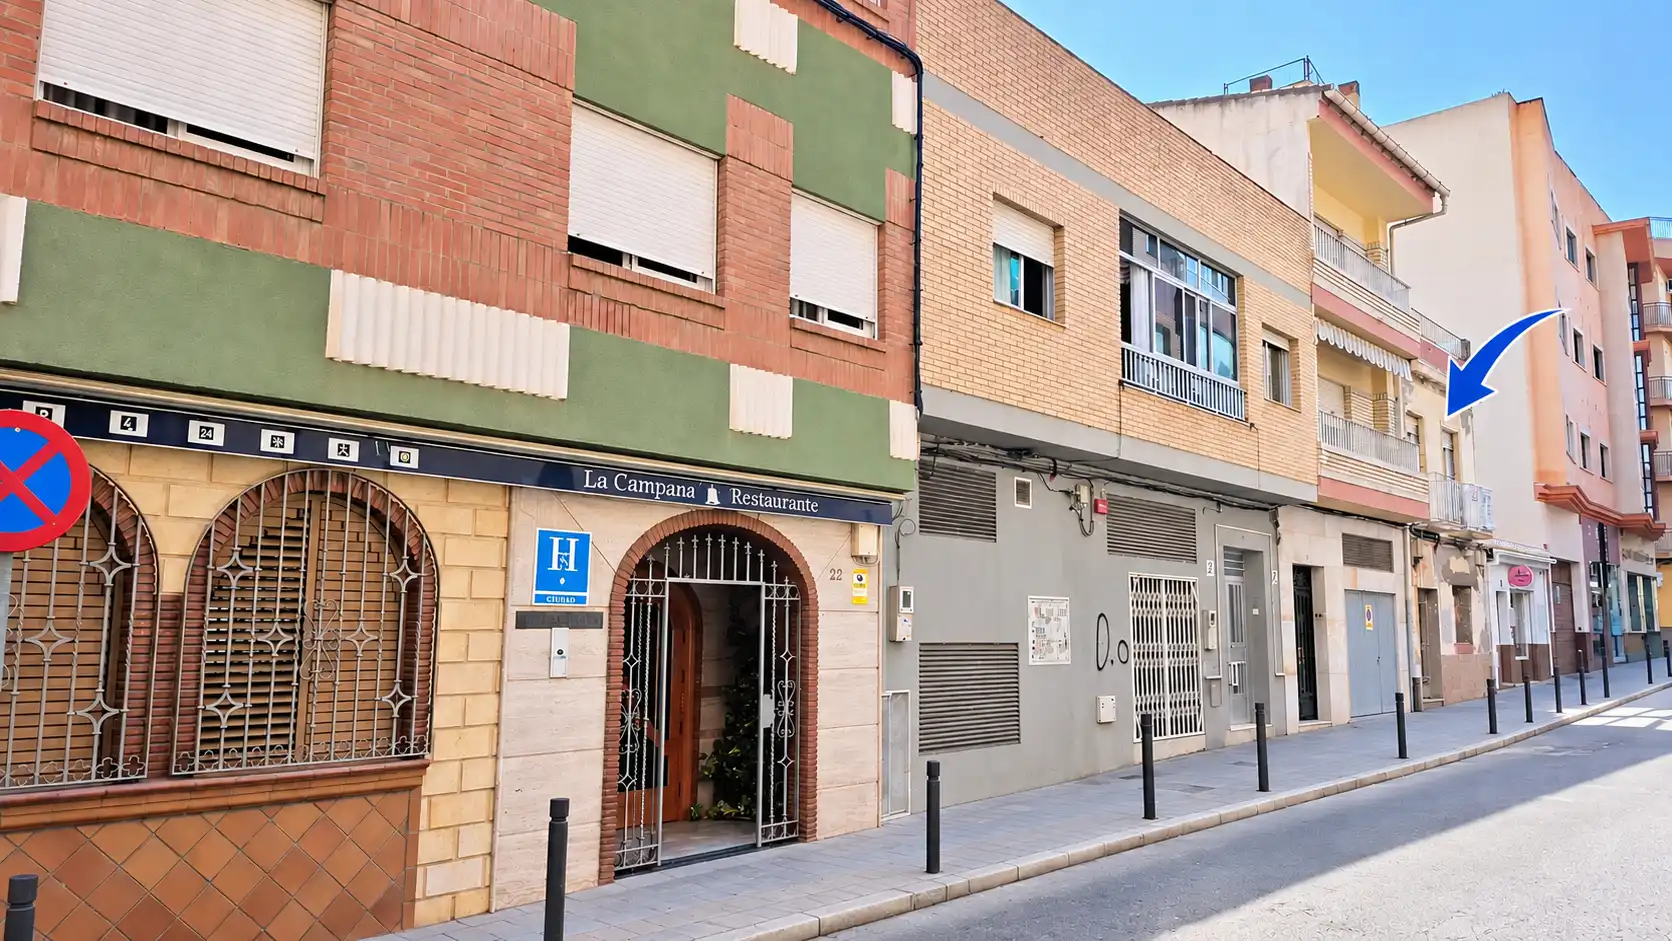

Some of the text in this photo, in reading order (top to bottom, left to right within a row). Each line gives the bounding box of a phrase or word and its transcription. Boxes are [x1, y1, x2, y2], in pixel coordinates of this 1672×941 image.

[200, 428, 213, 438] 24
[583, 469, 819, 512] La Campana Restaurante
[829, 568, 843, 581] 22
